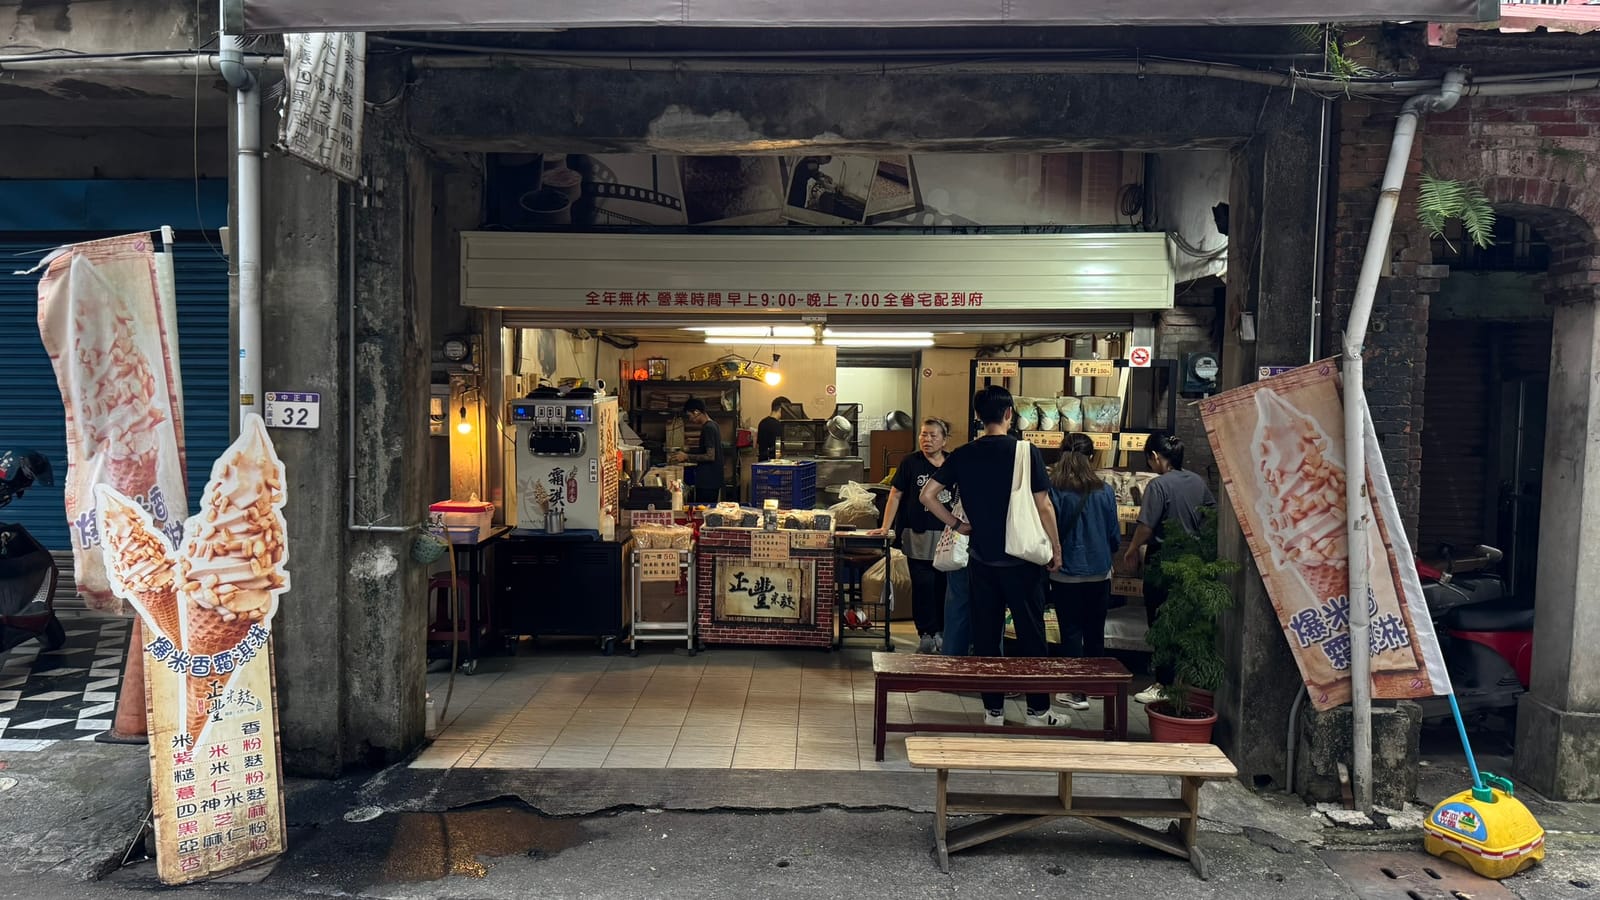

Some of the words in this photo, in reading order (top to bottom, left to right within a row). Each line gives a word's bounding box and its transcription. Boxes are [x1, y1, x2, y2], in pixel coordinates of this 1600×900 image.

[585, 291, 650, 306] 全年無休
[657, 292, 722, 307] 營業時間
[282, 407, 309, 426] 32
[548, 467, 565, 513] 霜淇
[146, 624, 270, 675] 爆米香霜淇淋
[1321, 612, 1408, 669] 霜淋
[171, 720, 261, 749] 米香
[173, 737, 262, 766] 紫米粉
[174, 754, 263, 784] 糙米麩
[175, 770, 265, 802] 薏仁粉
[176, 787, 266, 819] 四神米麩
[178, 803, 269, 837] 黑芝麻
[178, 821, 268, 854] 亞麻仁粉
[180, 837, 269, 873] 杏仁粉
